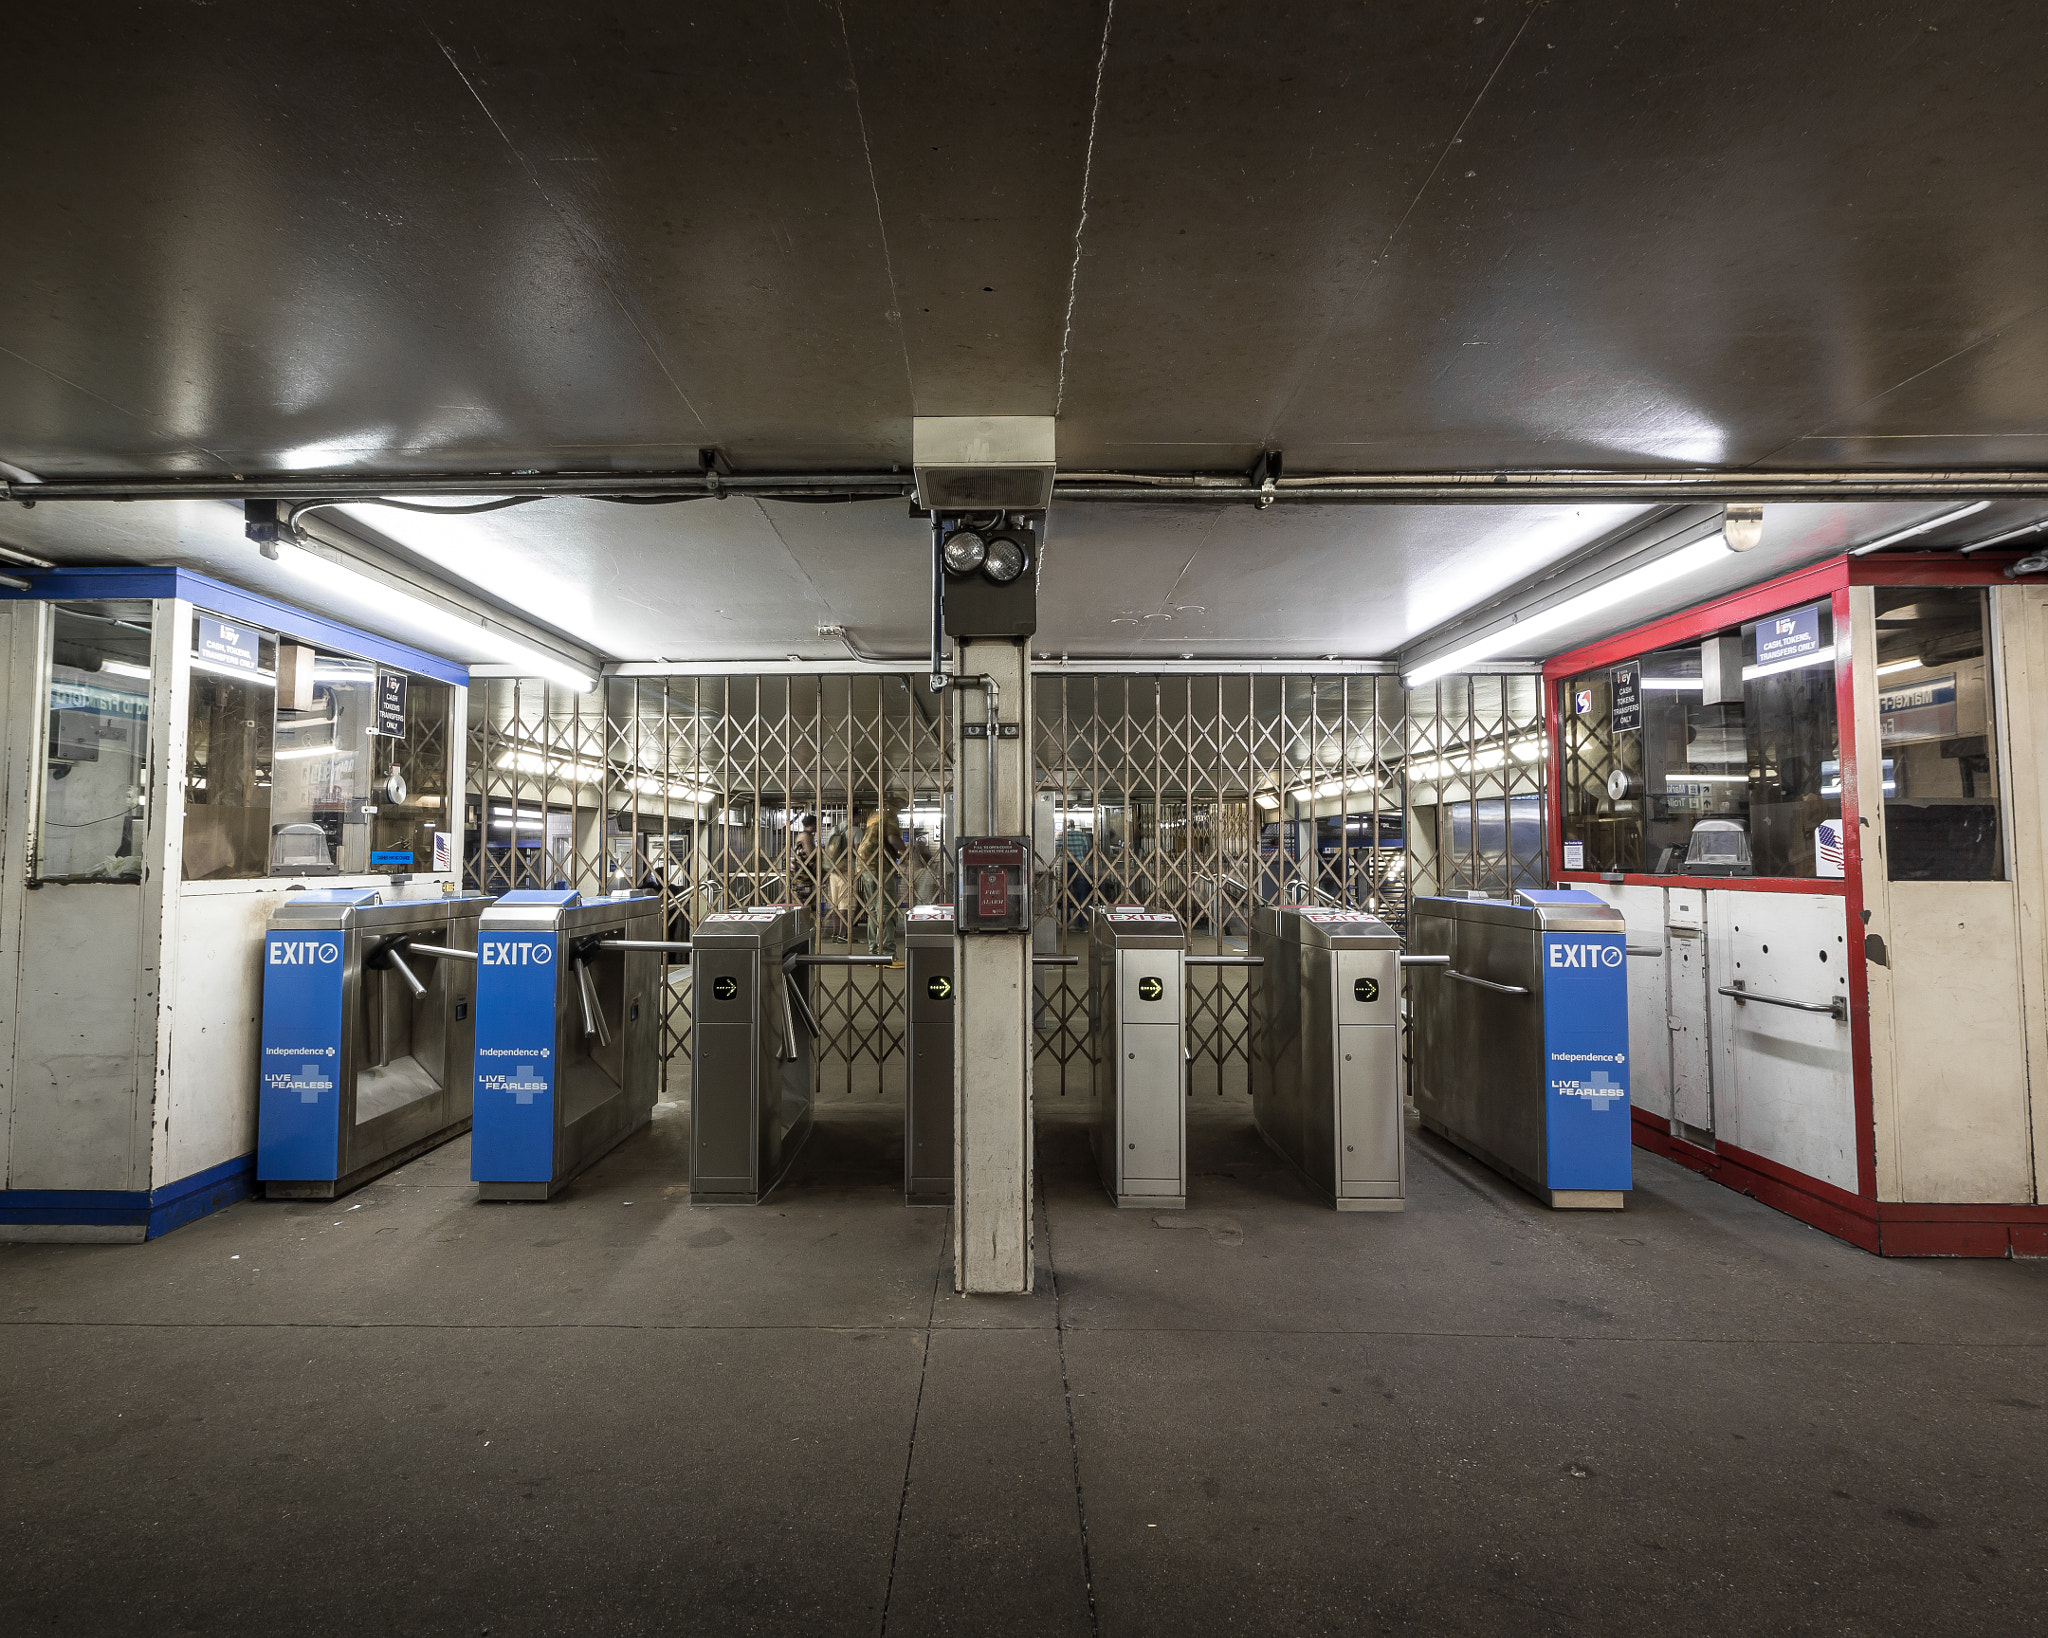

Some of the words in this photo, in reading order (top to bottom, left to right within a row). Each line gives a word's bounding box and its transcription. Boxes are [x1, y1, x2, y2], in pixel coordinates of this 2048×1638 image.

[1782, 632, 1811, 646] TOKENS,
[1760, 645, 1798, 661] TRANSFERS
[1797, 640, 1816, 652] ONLY
[201, 648, 239, 665] TRANSFERS
[239, 658, 256, 669] ONLY
[1619, 686, 1632, 695] CASH
[386, 693, 398, 702] CASH
[1617, 695, 1635, 705] TOKENS
[383, 702, 400, 712] TOKENS
[1613, 704, 1639, 715] TRANSFERS
[380, 710, 404, 721] TRANSFERS
[1620, 715, 1632, 724] ONLY
[386, 721, 398, 729] ONLY
[270, 942, 319, 964] EXIT
[483, 942, 533, 965] EXIT
[1550, 944, 1602, 967] EXIT
[265, 1047, 324, 1056] Independence
[480, 1048, 539, 1057] Independence
[1551, 1052, 1613, 1062] Independence
[271, 1081, 333, 1089] FEARLESS
[1551, 1080, 1580, 1088] LIVE
[1559, 1088, 1625, 1097] FEARLESS
